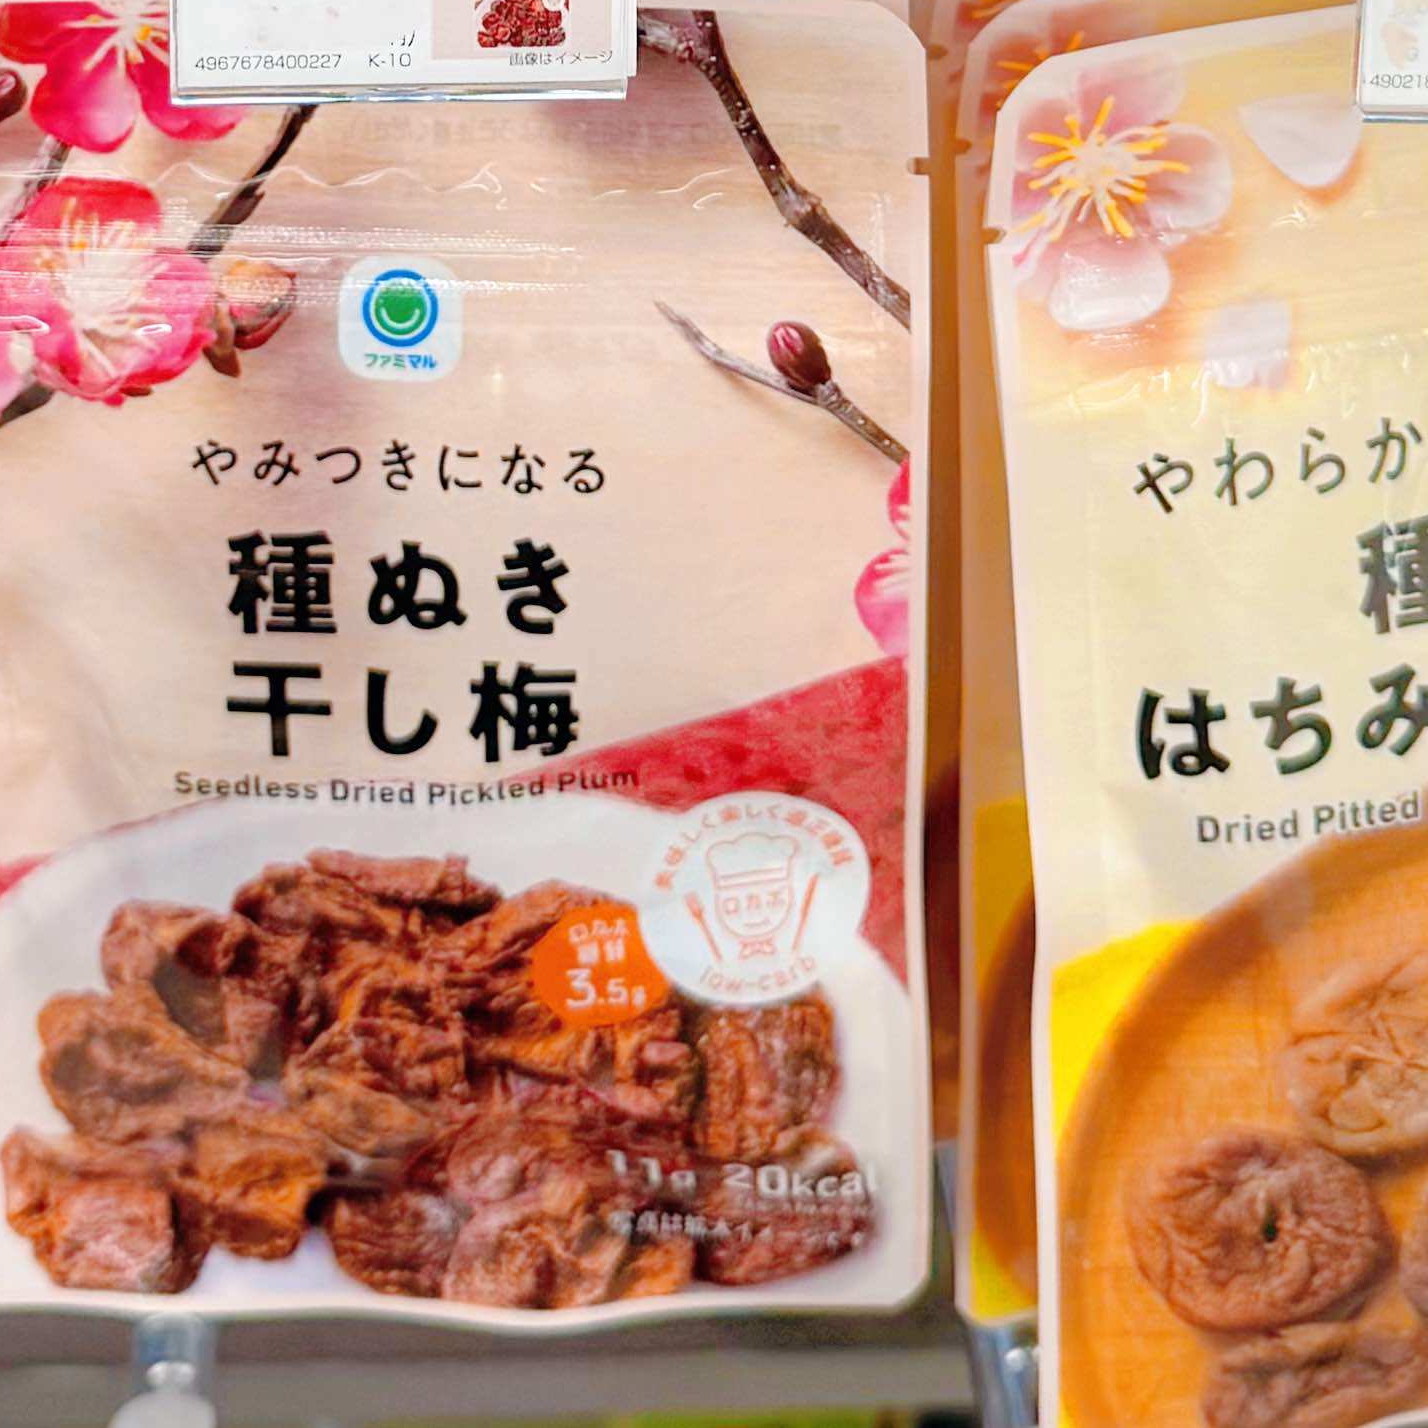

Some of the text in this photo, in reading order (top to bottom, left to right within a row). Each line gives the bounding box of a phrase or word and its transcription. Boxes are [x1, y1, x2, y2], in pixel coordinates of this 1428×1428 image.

[194, 52, 413, 71] 4967678400227 K-10
[363, 352, 437, 371] ファミマル
[190, 439, 607, 497] やみつきになる
[226, 529, 571, 637] 種ぬき
[225, 660, 579, 765] 干し梅
[174, 767, 640, 806] Seedless Dried Pickled Plum
[1195, 808, 1300, 846] Dried
[1312, 790, 1421, 837] Pitted
[722, 1162, 879, 1199] 20kcal
